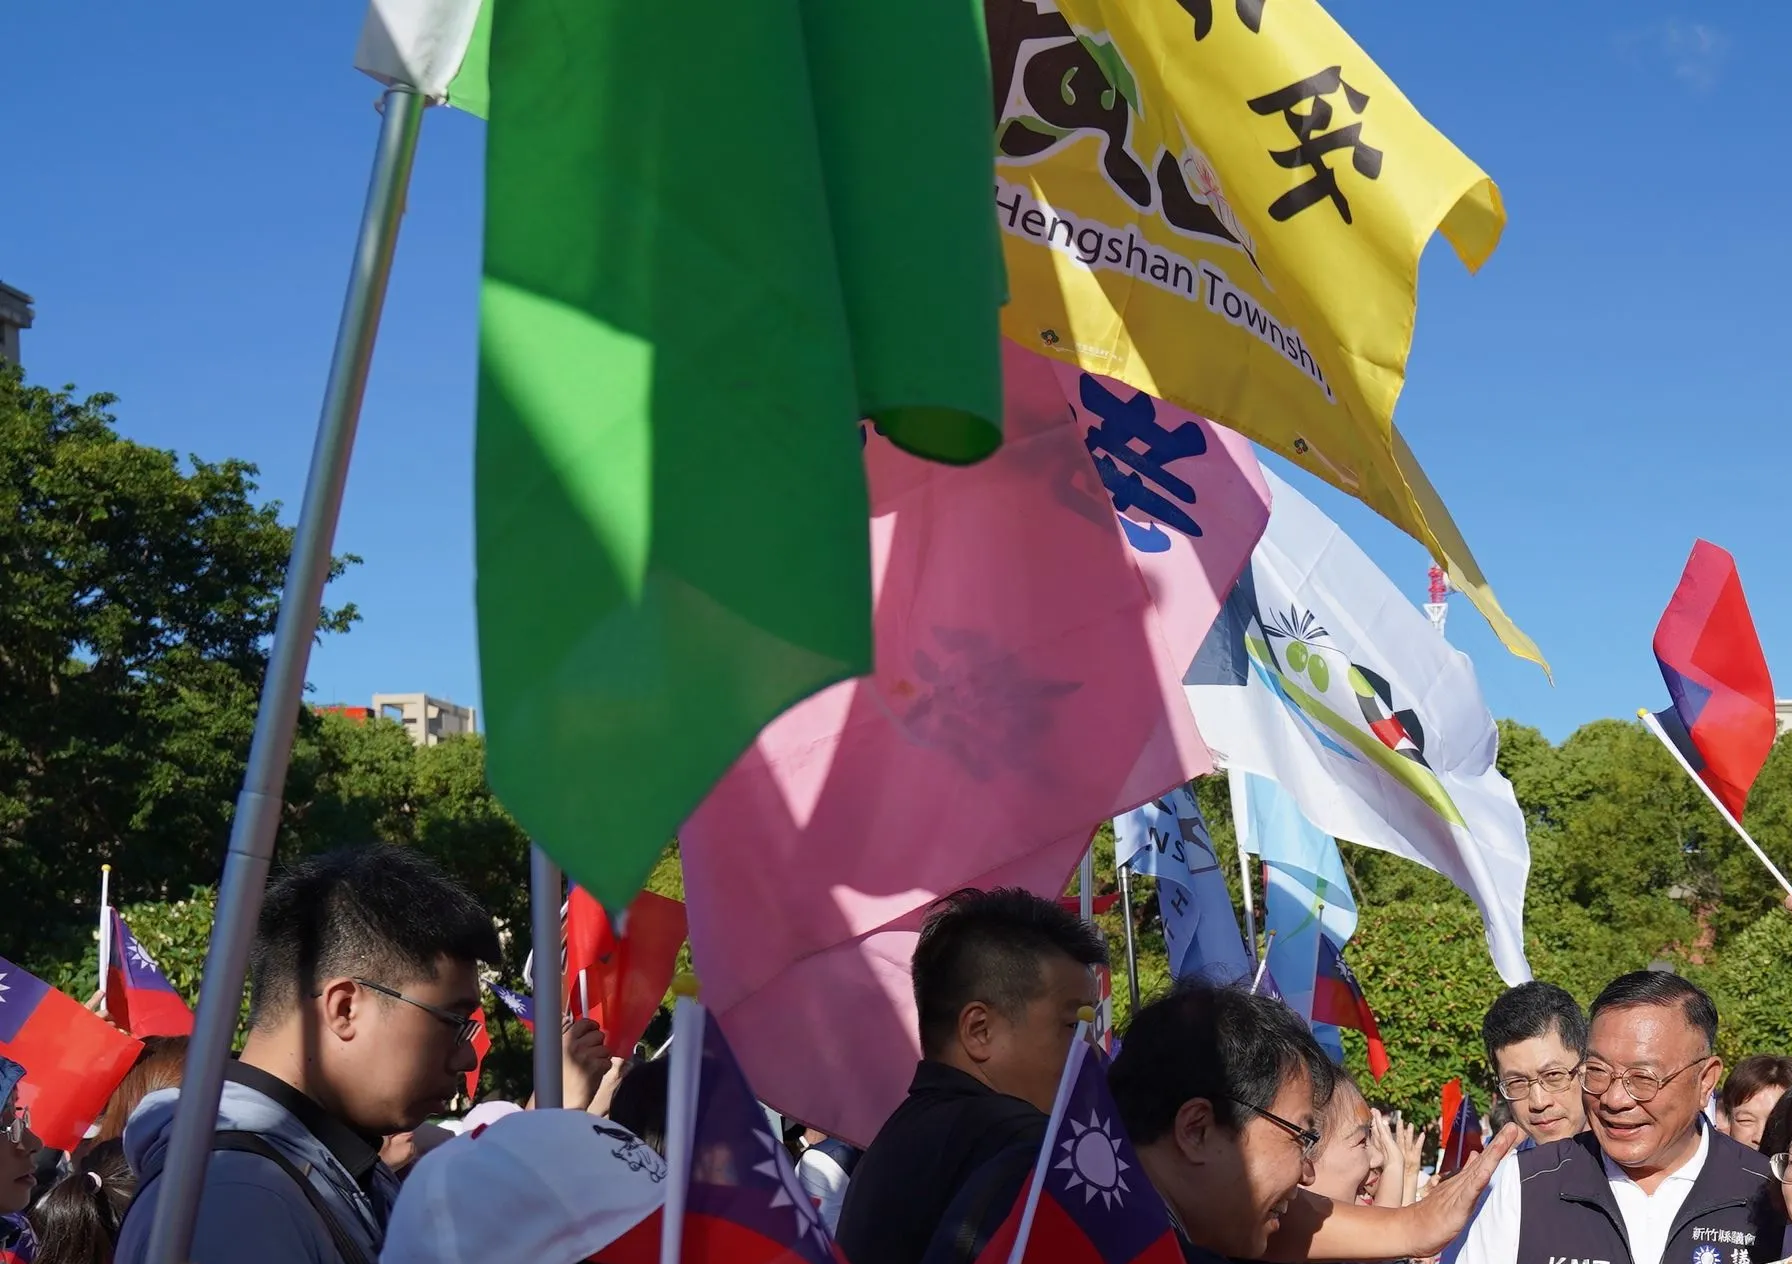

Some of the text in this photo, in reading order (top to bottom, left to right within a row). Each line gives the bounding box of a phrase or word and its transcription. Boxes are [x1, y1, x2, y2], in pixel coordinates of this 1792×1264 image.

[995, 186, 1332, 397] Hengshan Townshi
[1691, 1226, 1756, 1246] 新竹縣議會
